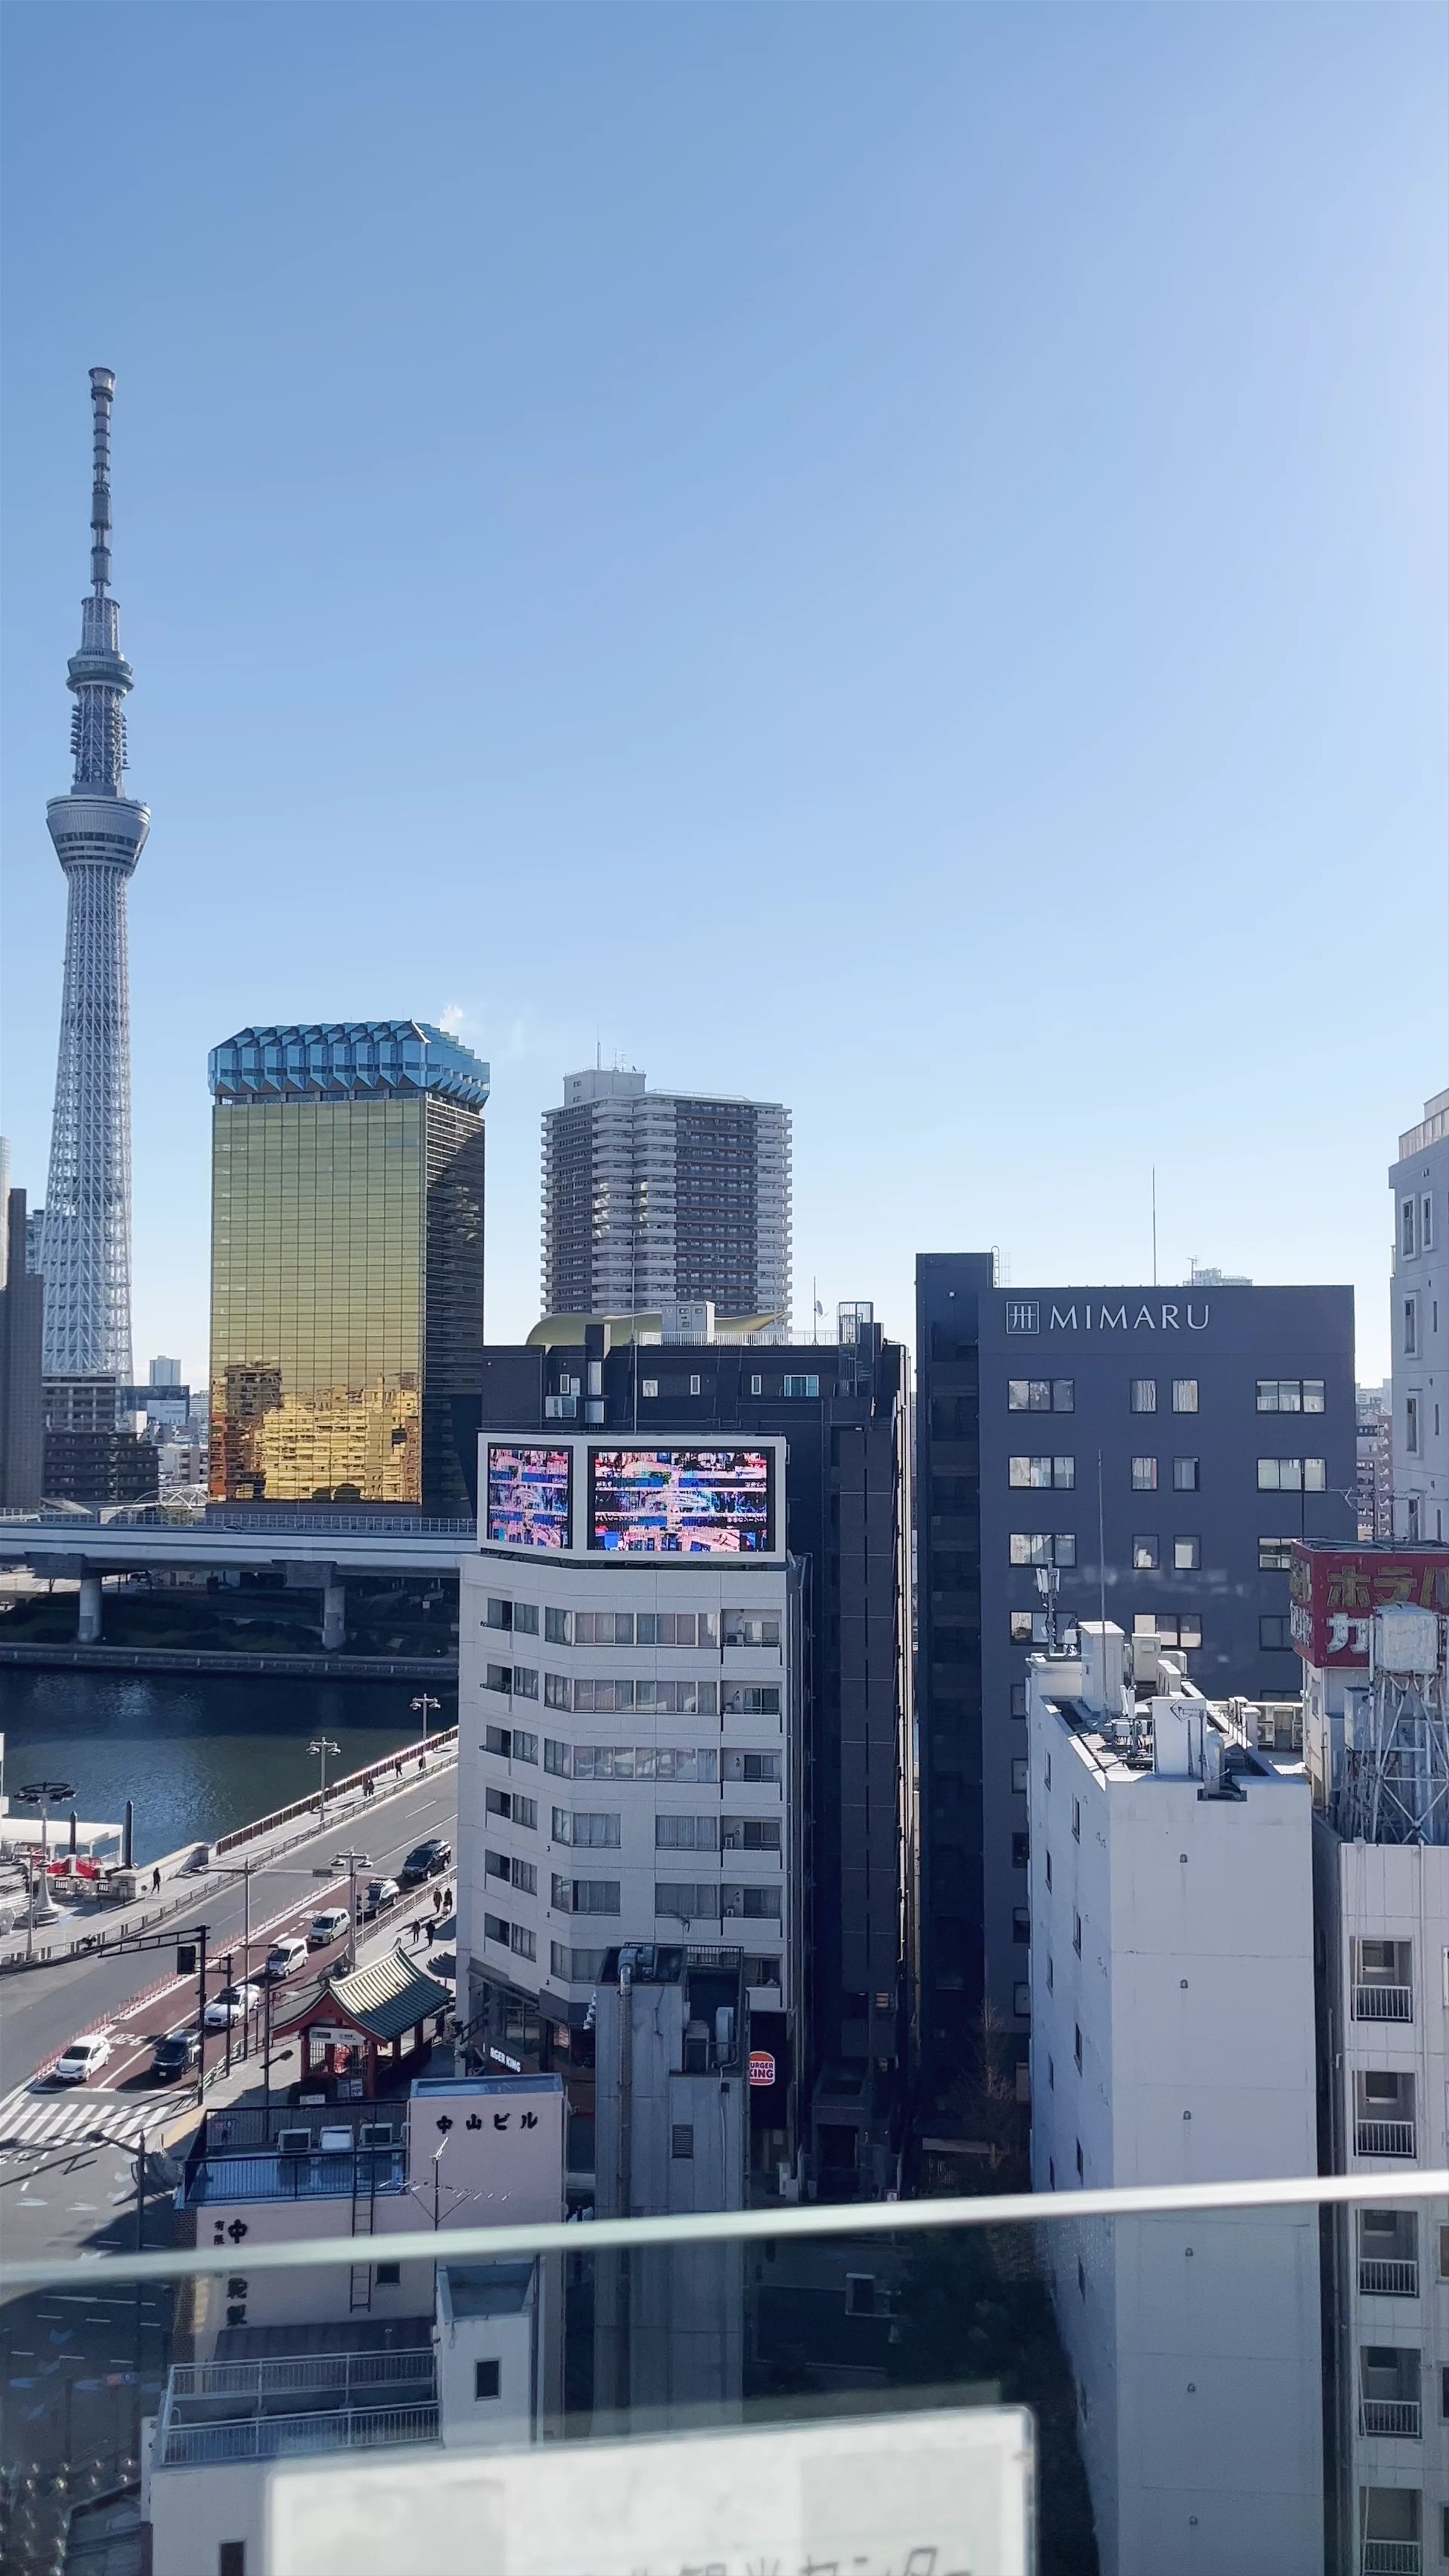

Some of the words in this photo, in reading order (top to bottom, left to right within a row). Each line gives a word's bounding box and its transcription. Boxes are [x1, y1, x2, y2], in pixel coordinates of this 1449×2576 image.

[1049, 1304, 1209, 1330] MIMARU
[506, 2055, 521, 2073] KING
[436, 2111, 538, 2135] 中山ビル
